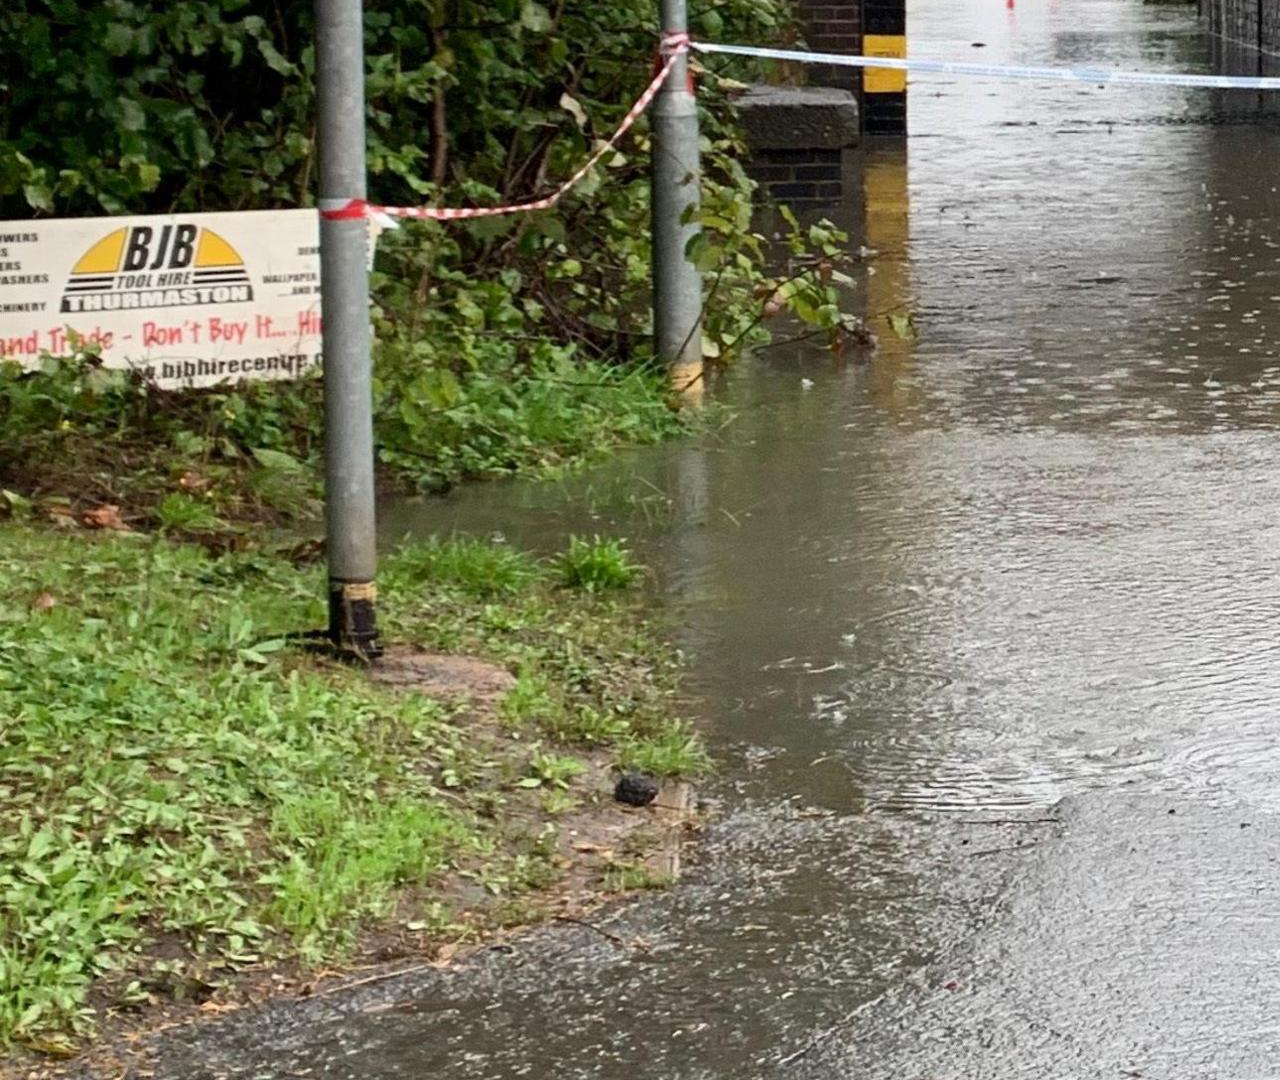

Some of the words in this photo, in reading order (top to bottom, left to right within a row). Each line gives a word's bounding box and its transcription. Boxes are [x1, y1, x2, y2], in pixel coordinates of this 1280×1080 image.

[122, 223, 198, 272] BJB
[116, 274, 151, 290] TOOL
[156, 271, 192, 287] HIRE
[64, 285, 248, 312] THURMASTON
[208, 317, 249, 345] Buy
